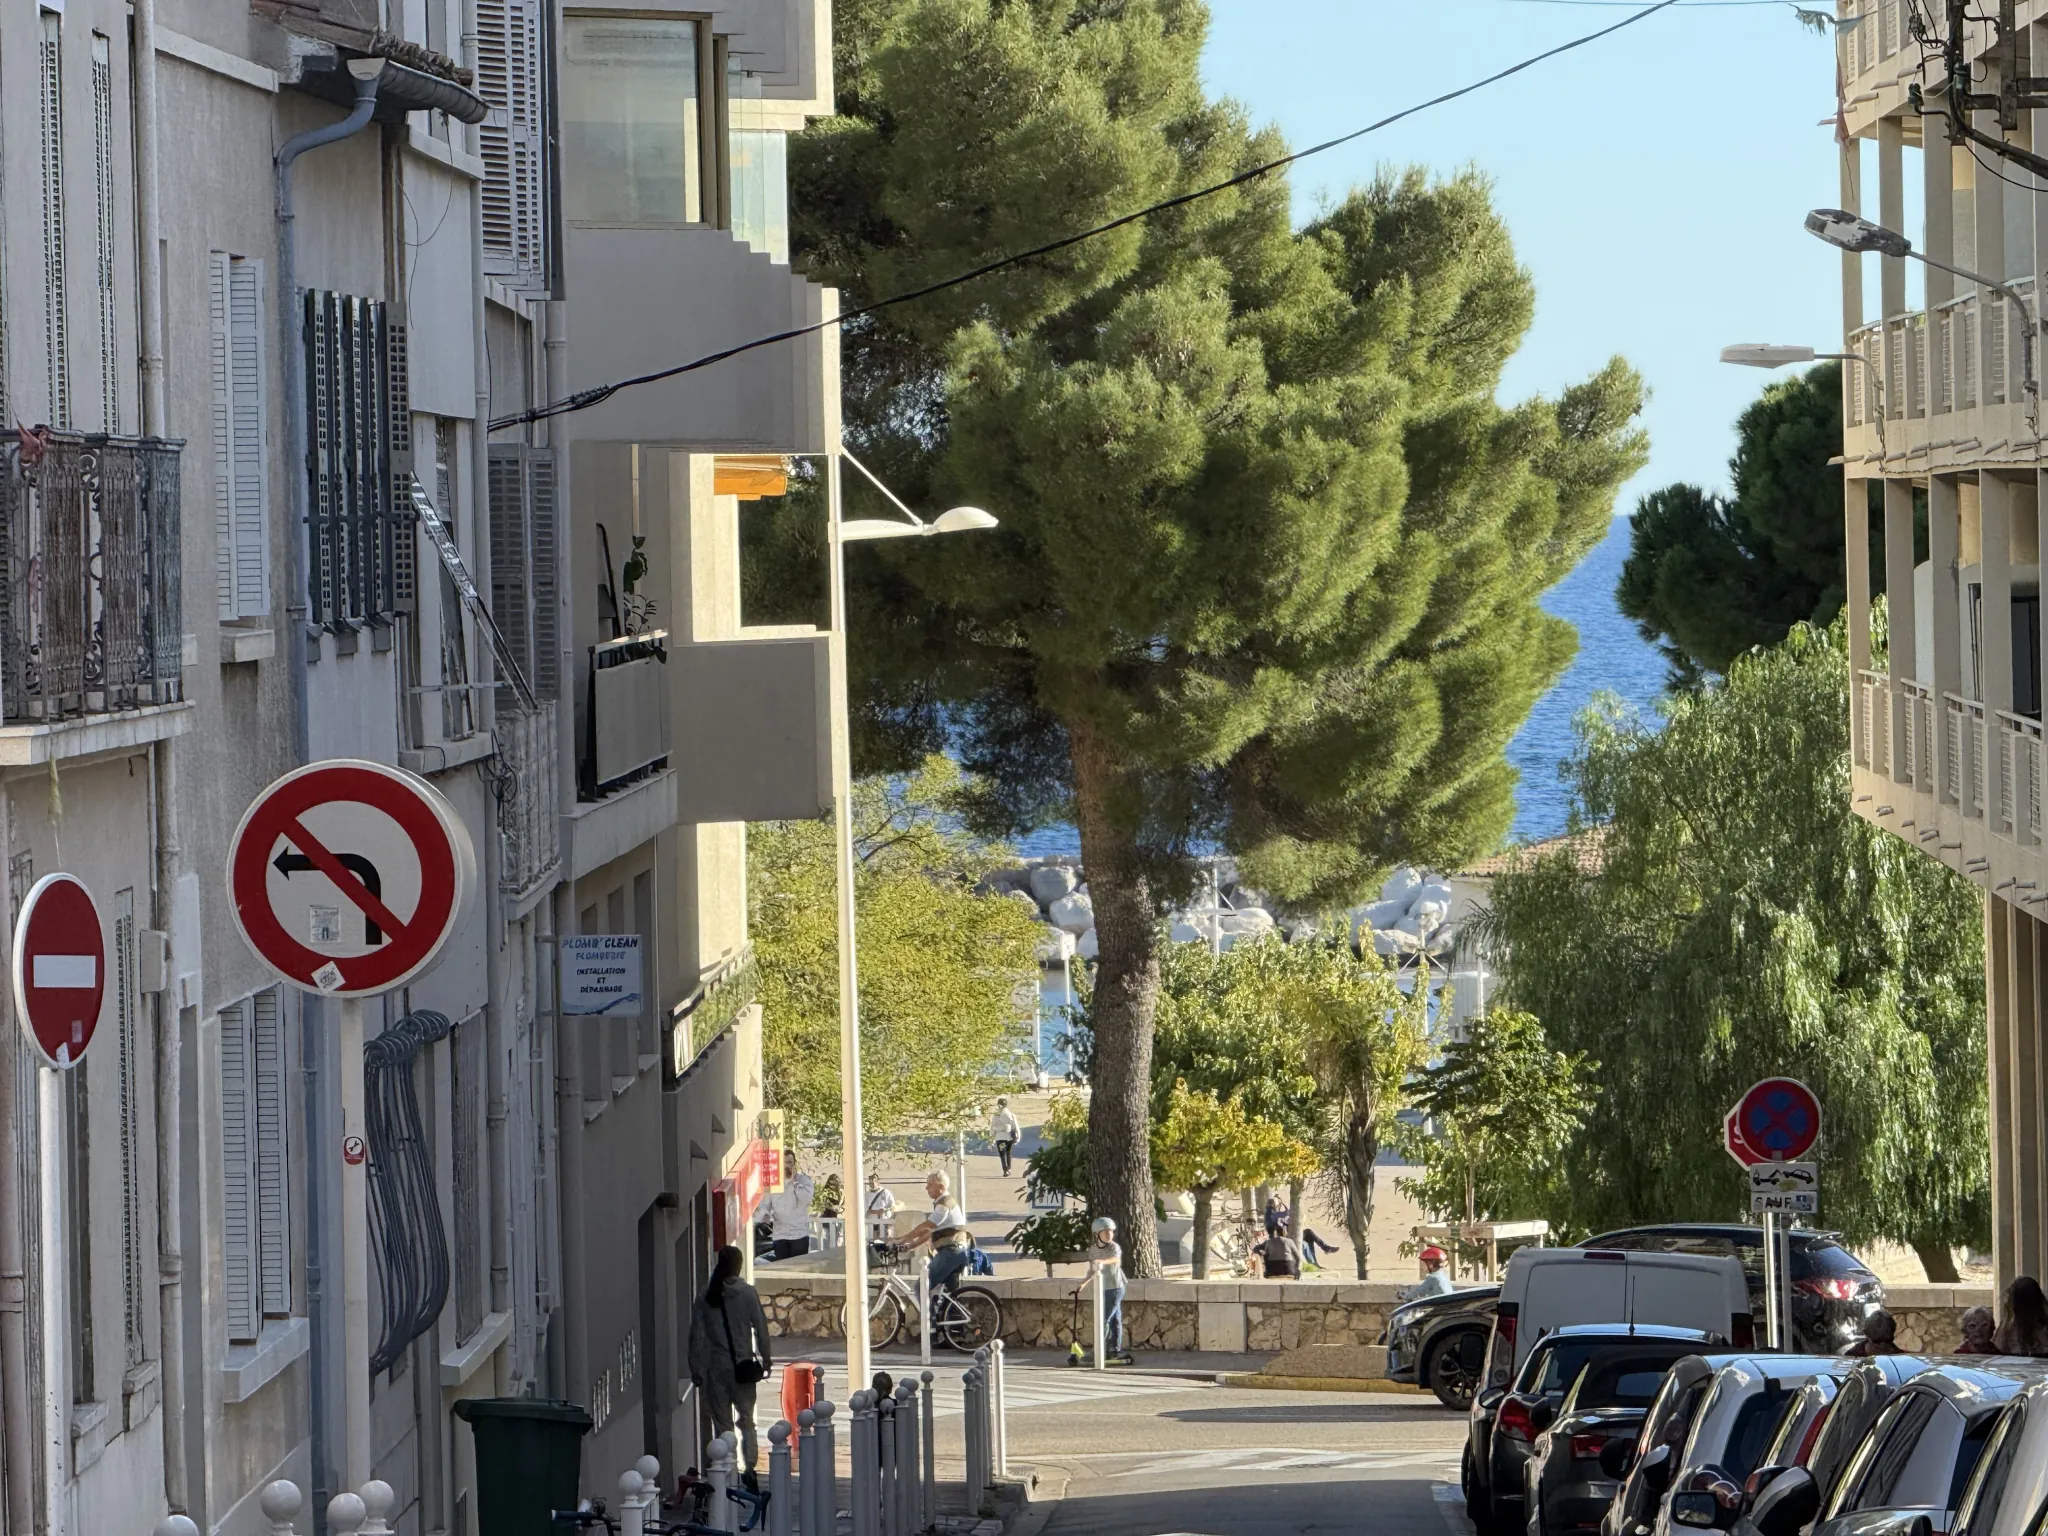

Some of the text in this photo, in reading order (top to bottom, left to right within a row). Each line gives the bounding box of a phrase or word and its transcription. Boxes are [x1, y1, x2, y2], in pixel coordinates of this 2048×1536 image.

[604, 937, 638, 949] CLEAN
[575, 951, 626, 960] PLOMBERIE
[576, 967, 626, 975] INSTALLATION
